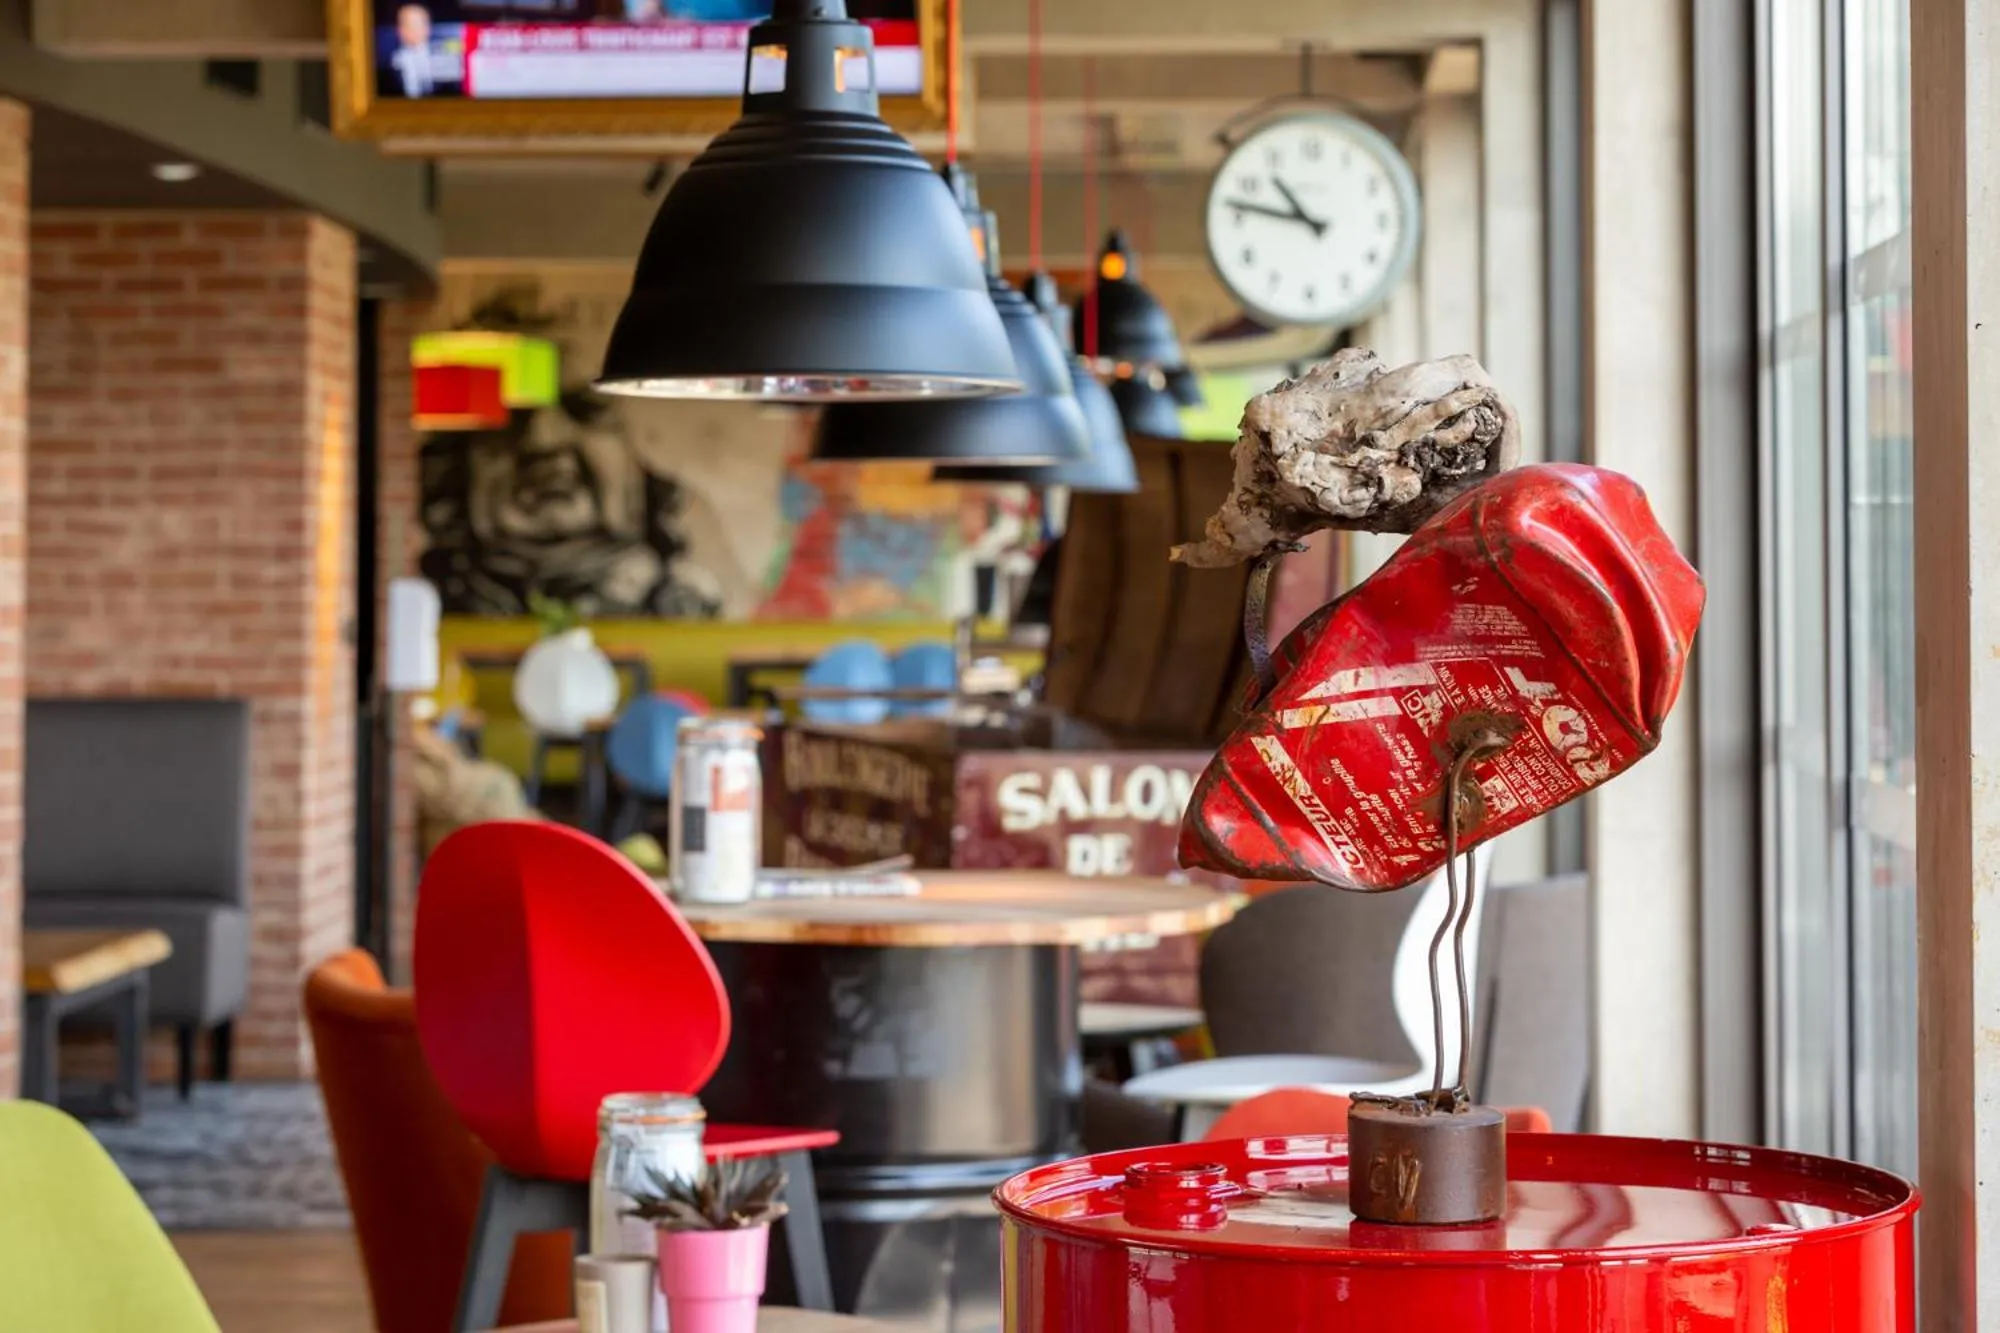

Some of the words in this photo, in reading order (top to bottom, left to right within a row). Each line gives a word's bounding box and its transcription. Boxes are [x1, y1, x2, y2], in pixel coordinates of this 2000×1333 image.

[998, 763, 1196, 833] SALON
[1338, 817, 1357, 836] ABC
[1066, 831, 1134, 878] DE
